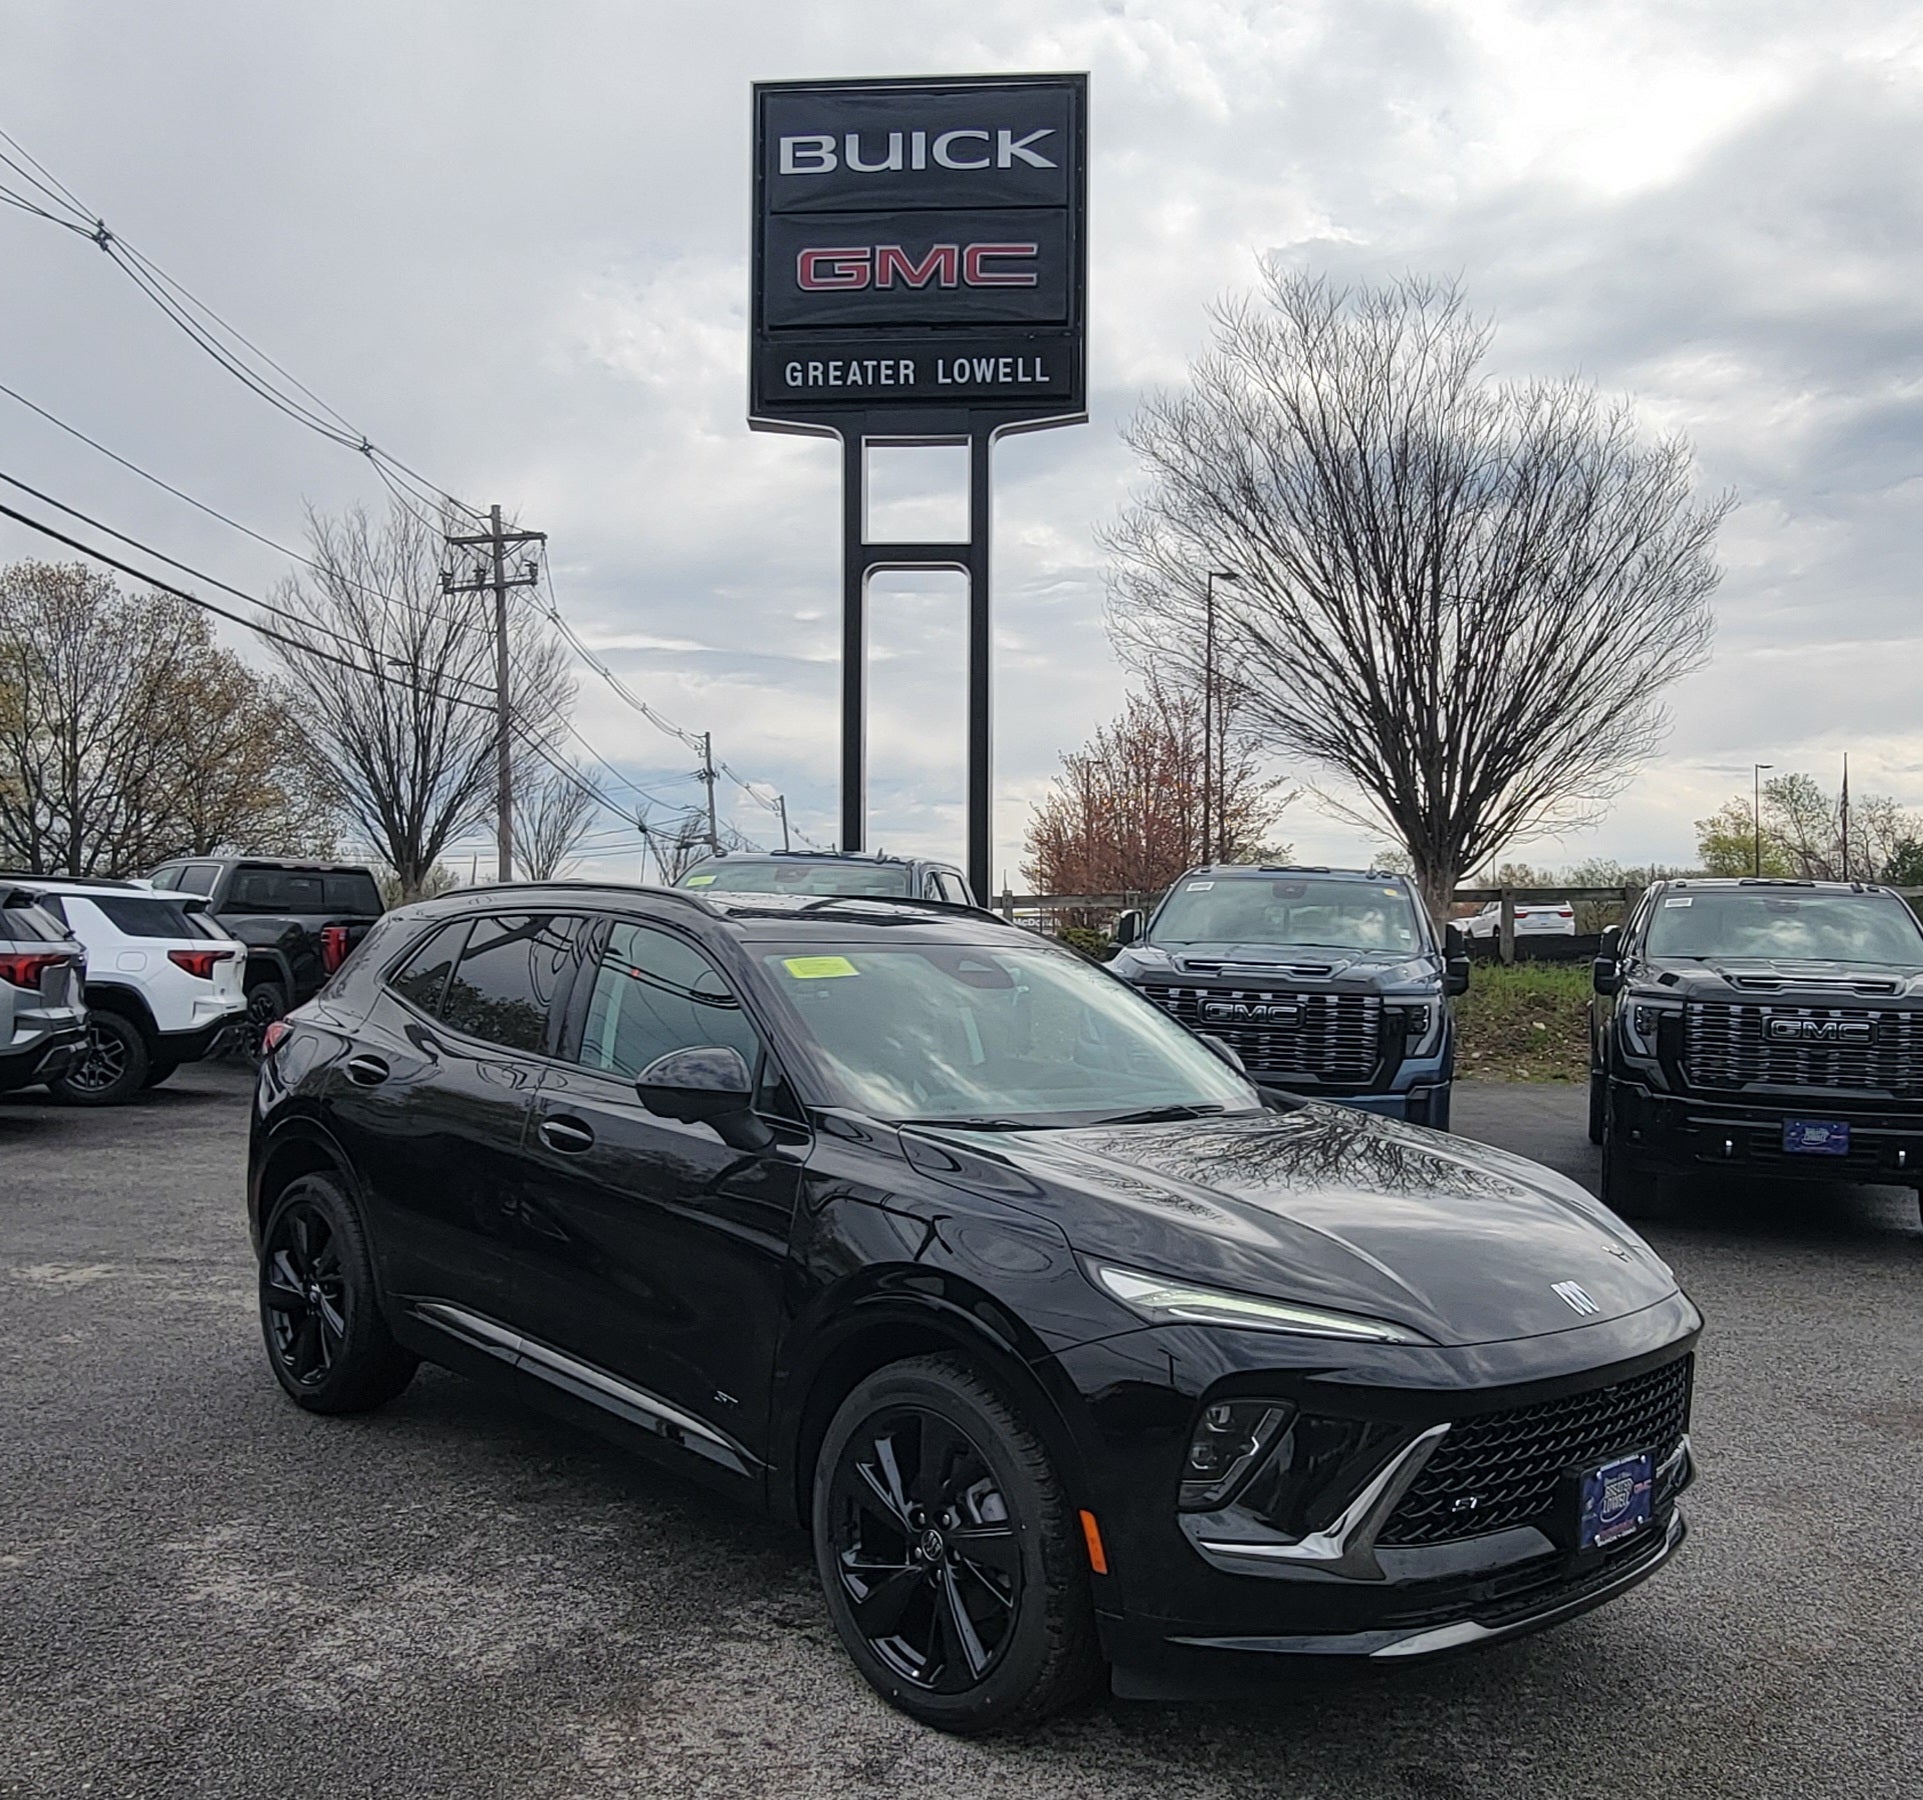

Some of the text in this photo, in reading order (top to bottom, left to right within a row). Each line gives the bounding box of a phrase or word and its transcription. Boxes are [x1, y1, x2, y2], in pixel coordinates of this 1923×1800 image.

[779, 129, 1059, 175] BUICK
[796, 242, 1039, 291] GMC
[785, 357, 1051, 387] GREATER LOWELL
[1205, 1002, 1298, 1024] GMC
[1770, 1020, 1870, 1041] GMC
